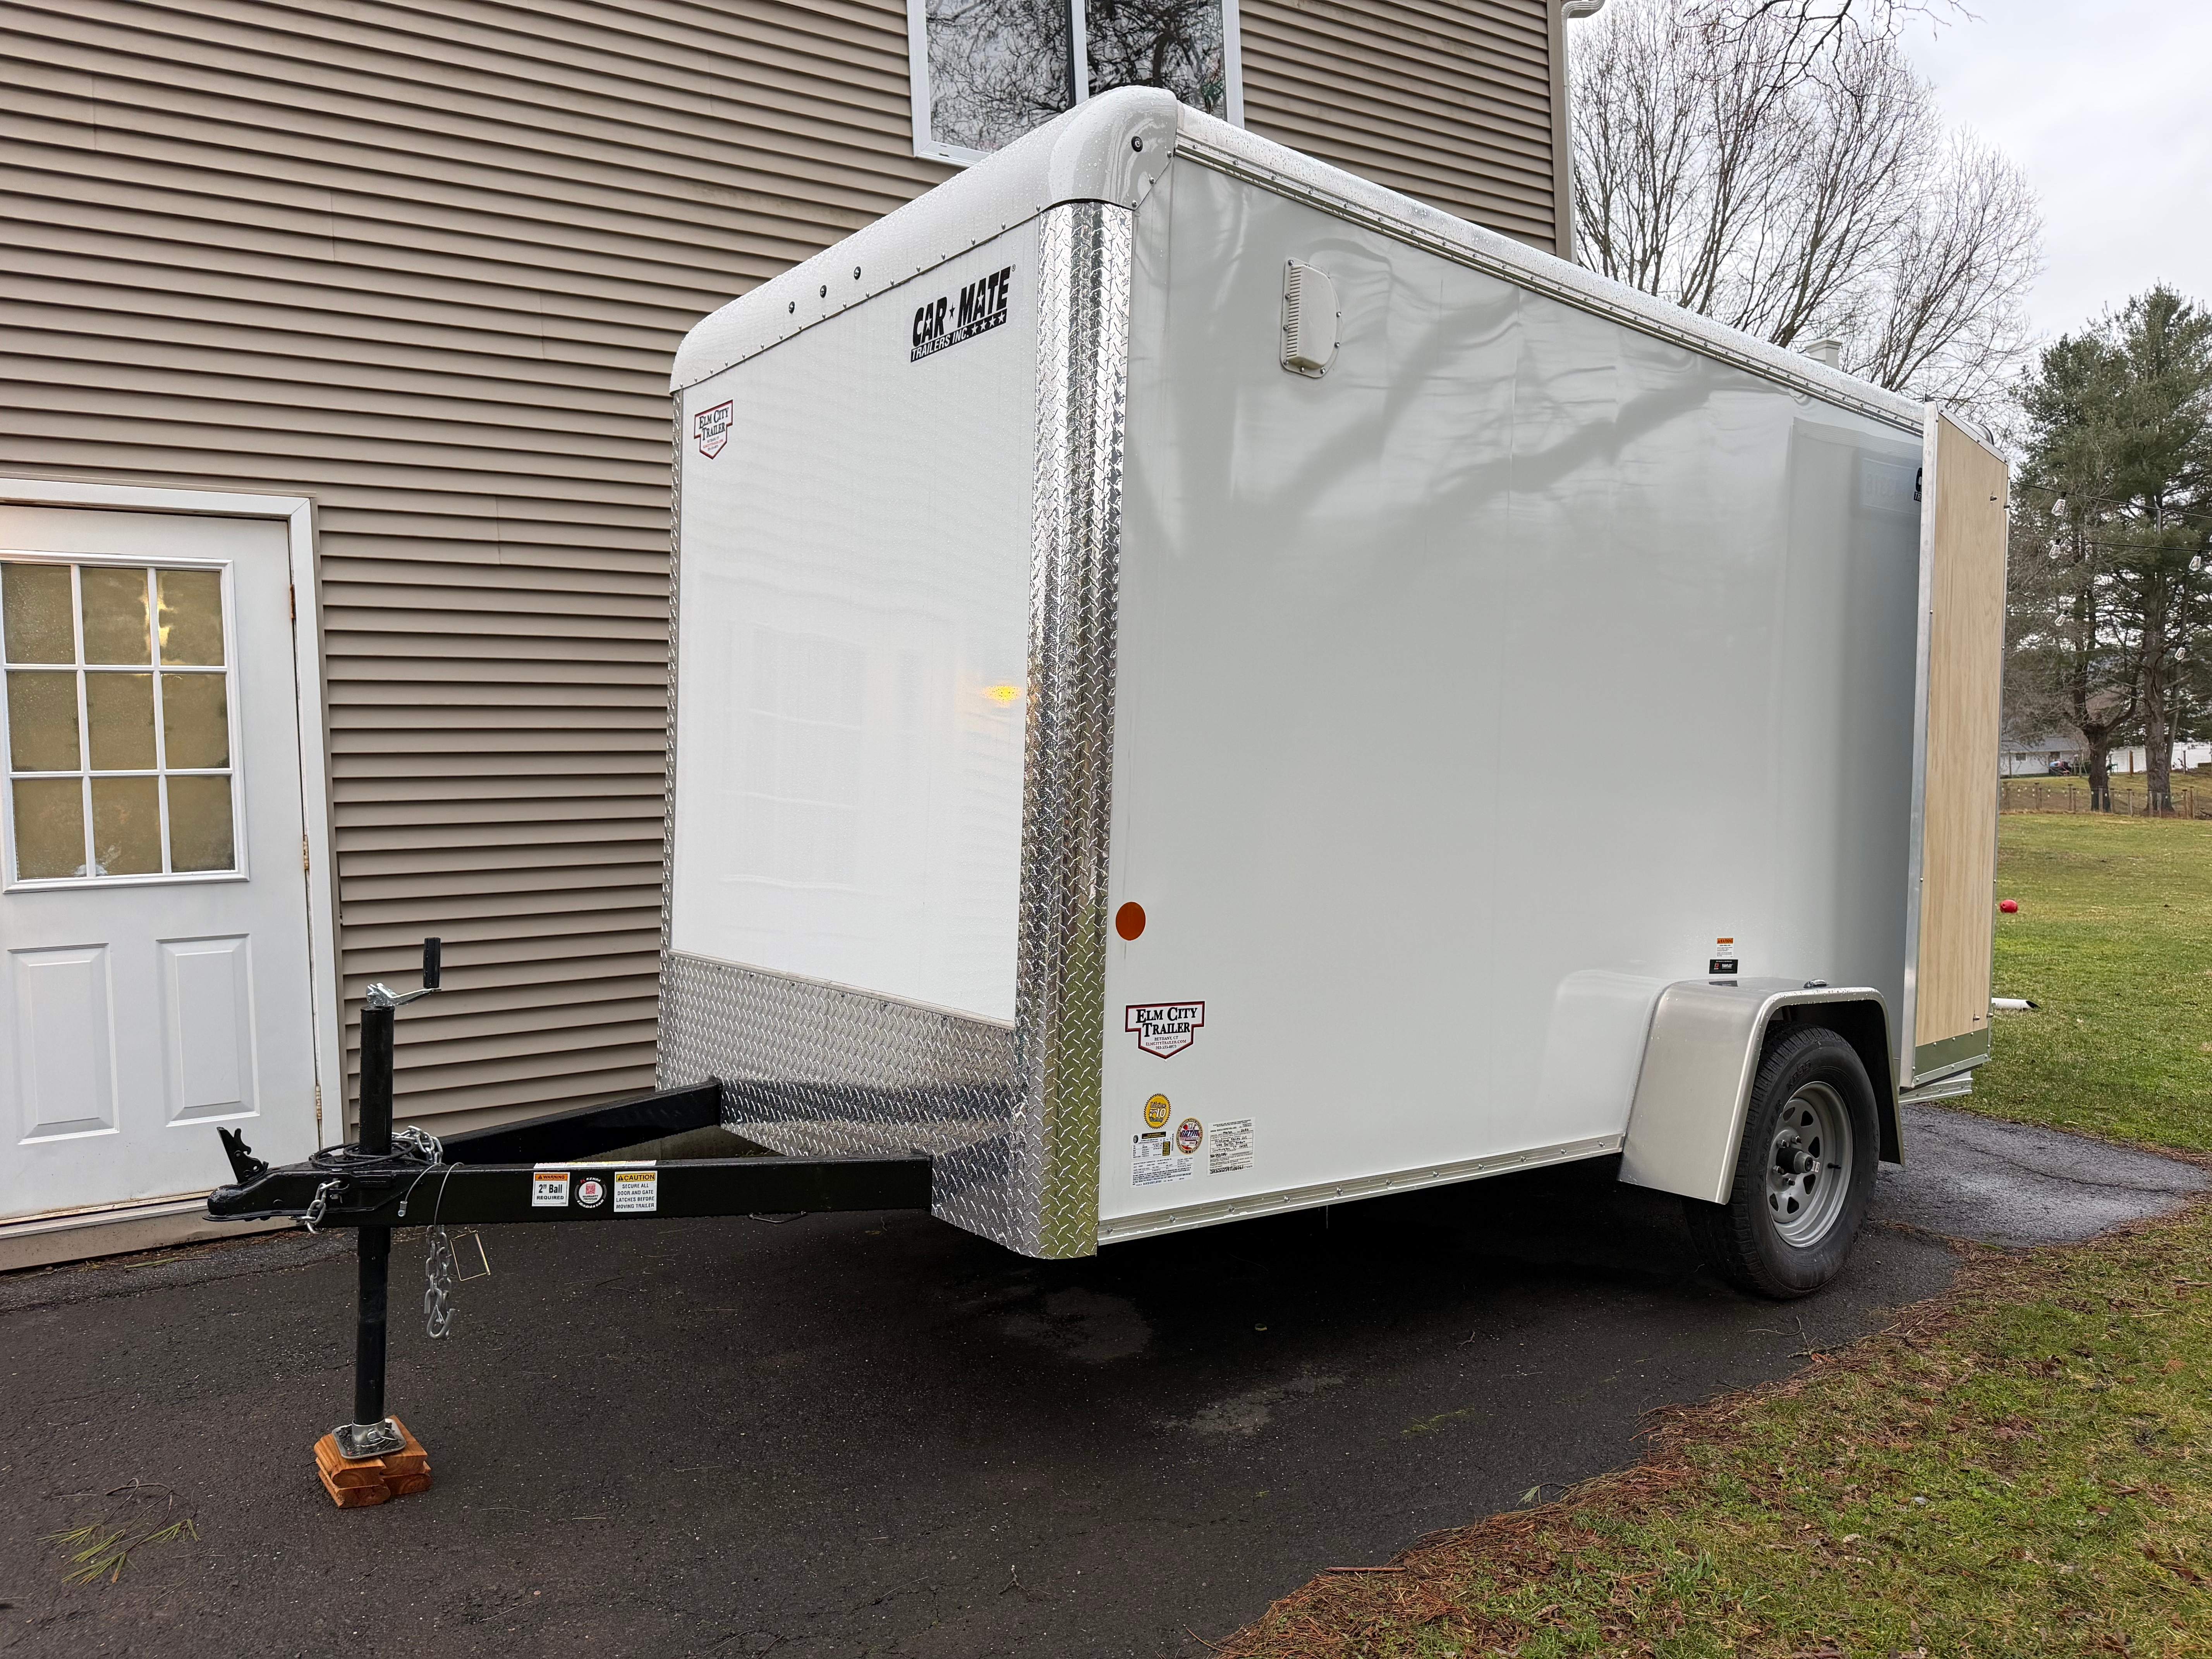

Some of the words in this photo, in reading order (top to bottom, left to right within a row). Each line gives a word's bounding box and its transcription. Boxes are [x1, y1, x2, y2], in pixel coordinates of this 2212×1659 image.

[913, 296, 947, 347] CAR
[957, 266, 1011, 328] MATE
[912, 335, 950, 361] TRAILERS
[952, 327, 969, 343] INC.
[1156, 1108, 1166, 1118] 10
[549, 1184, 562, 1193] Ball
